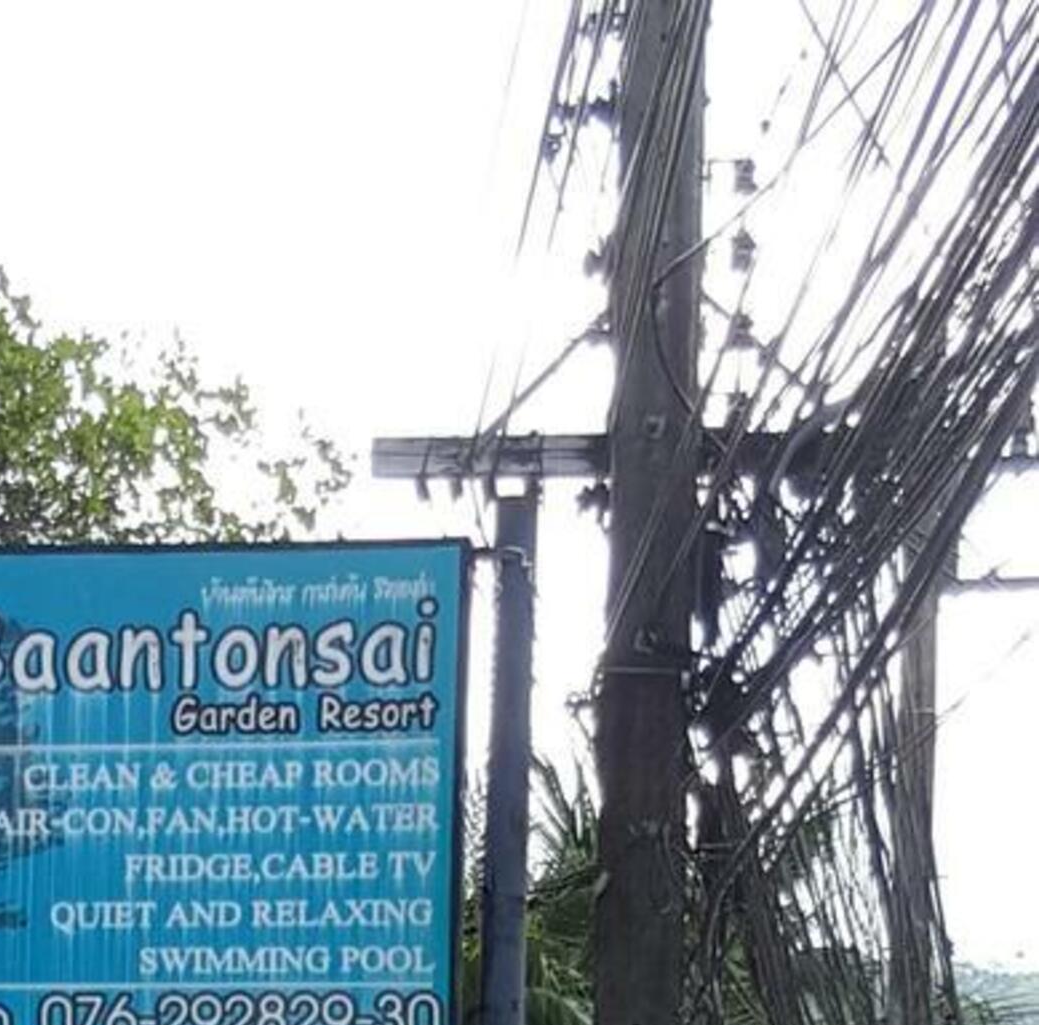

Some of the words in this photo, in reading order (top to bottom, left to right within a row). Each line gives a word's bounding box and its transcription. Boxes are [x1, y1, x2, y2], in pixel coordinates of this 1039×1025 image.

[172, 696, 298, 734] Garden
[318, 695, 436, 731] Resort
[22, 763, 141, 792] CLEAN
[150, 761, 177, 789] &
[186, 760, 303, 790] CHEAP
[312, 757, 439, 788] ROOMS
[124, 854, 379, 884] FRIDGE,CABLE
[388, 851, 437, 878] TV
[50, 902, 156, 935] QUIET
[166, 901, 242, 927] AND
[251, 899, 434, 928] RELAXING
[139, 947, 331, 976] SWIMMING
[340, 945, 435, 973] POOL
